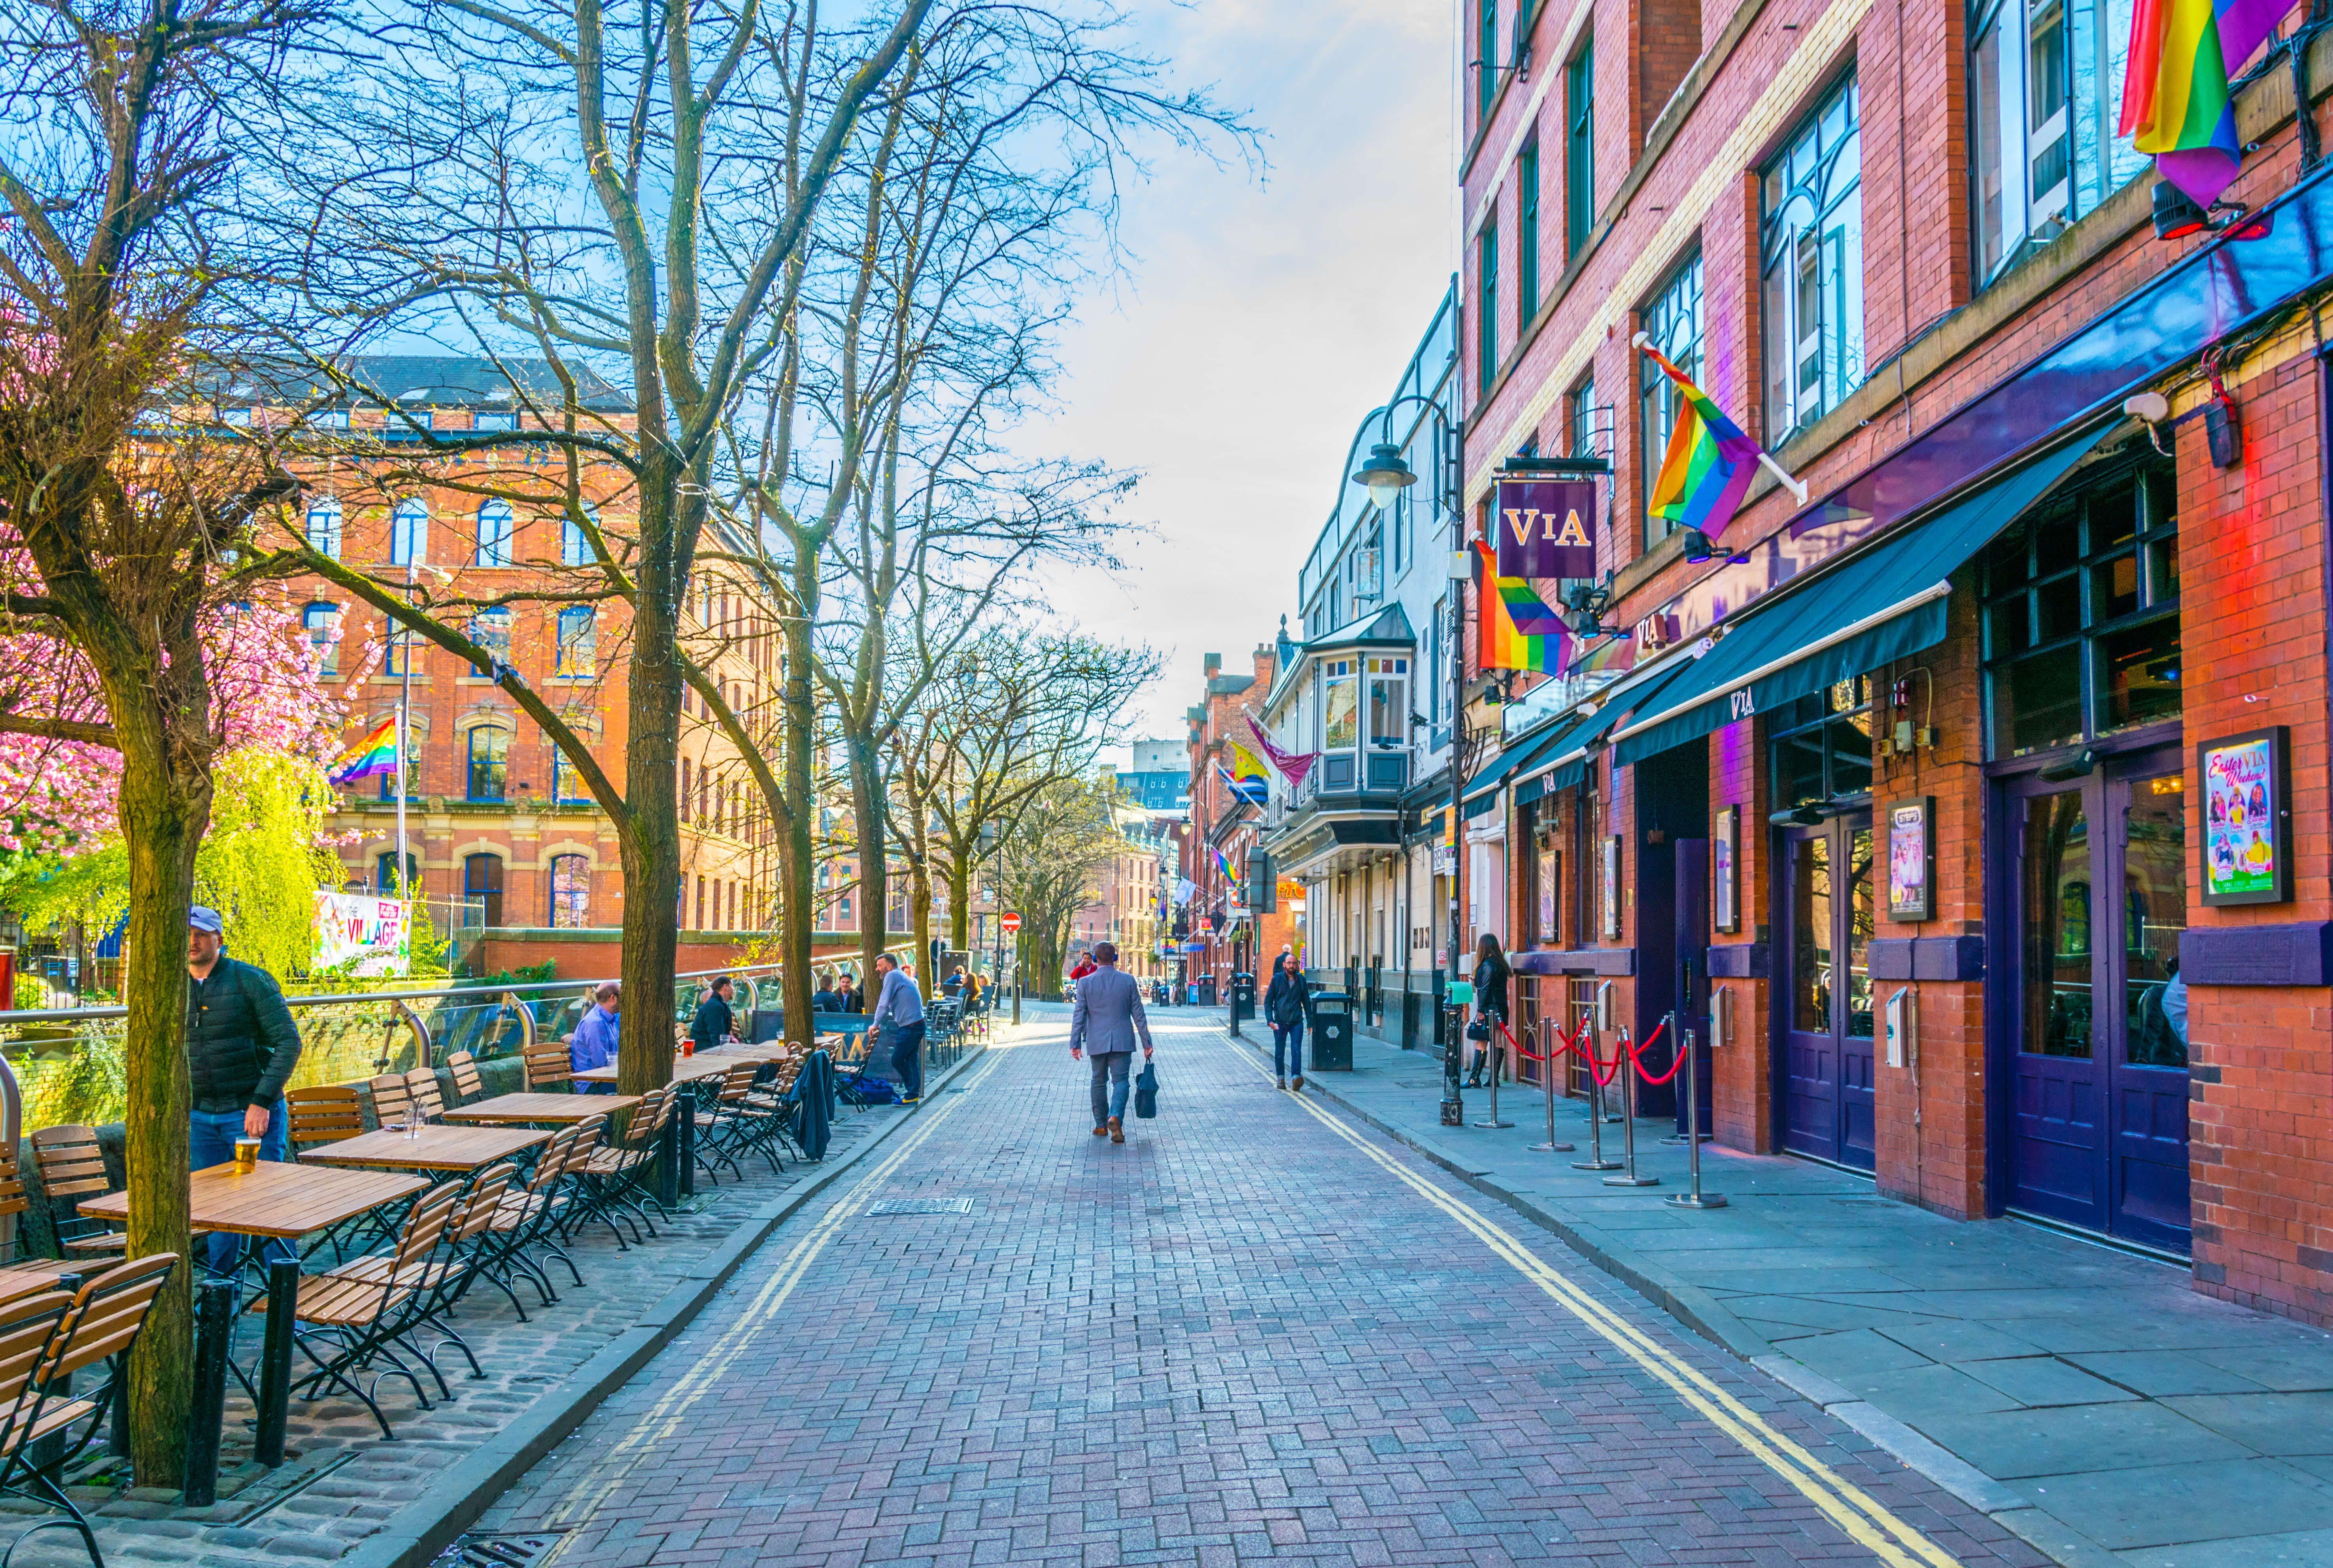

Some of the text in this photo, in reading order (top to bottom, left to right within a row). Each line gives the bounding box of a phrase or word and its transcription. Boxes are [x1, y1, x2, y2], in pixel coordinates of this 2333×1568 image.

[1503, 508, 1592, 547] VIA
[1636, 613, 1659, 649] VIA
[1730, 686, 1755, 721] VIA
[2208, 754, 2243, 779] Easter
[2242, 751, 2266, 769] VIA
[1542, 771, 1556, 794] VIA
[2226, 768, 2266, 787] Weekend
[1898, 812, 1918, 823] STEPS
[348, 918, 398, 946] VILLAGE
